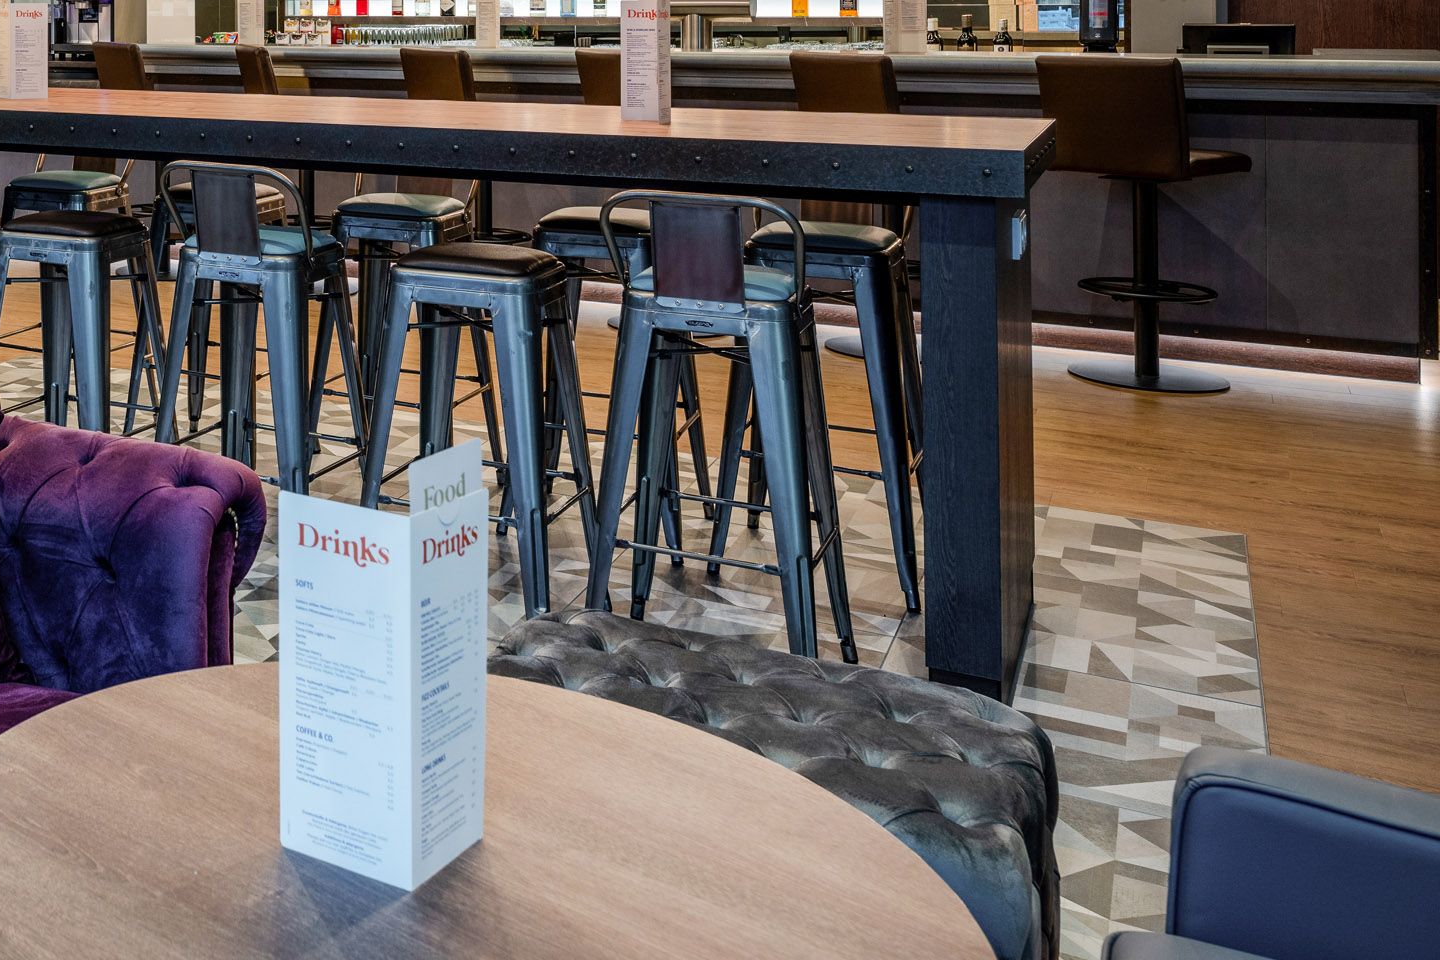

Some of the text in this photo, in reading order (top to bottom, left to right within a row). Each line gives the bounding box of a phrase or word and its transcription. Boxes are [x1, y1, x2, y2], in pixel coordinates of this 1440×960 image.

[15, 10, 43, 19] Drinks
[628, 9, 657, 20] Drink
[424, 473, 466, 510] Food
[297, 522, 390, 568] Drinks
[422, 524, 478, 565] Drinks
[295, 578, 314, 590] SOFTS
[296, 725, 317, 738] COFFEE
